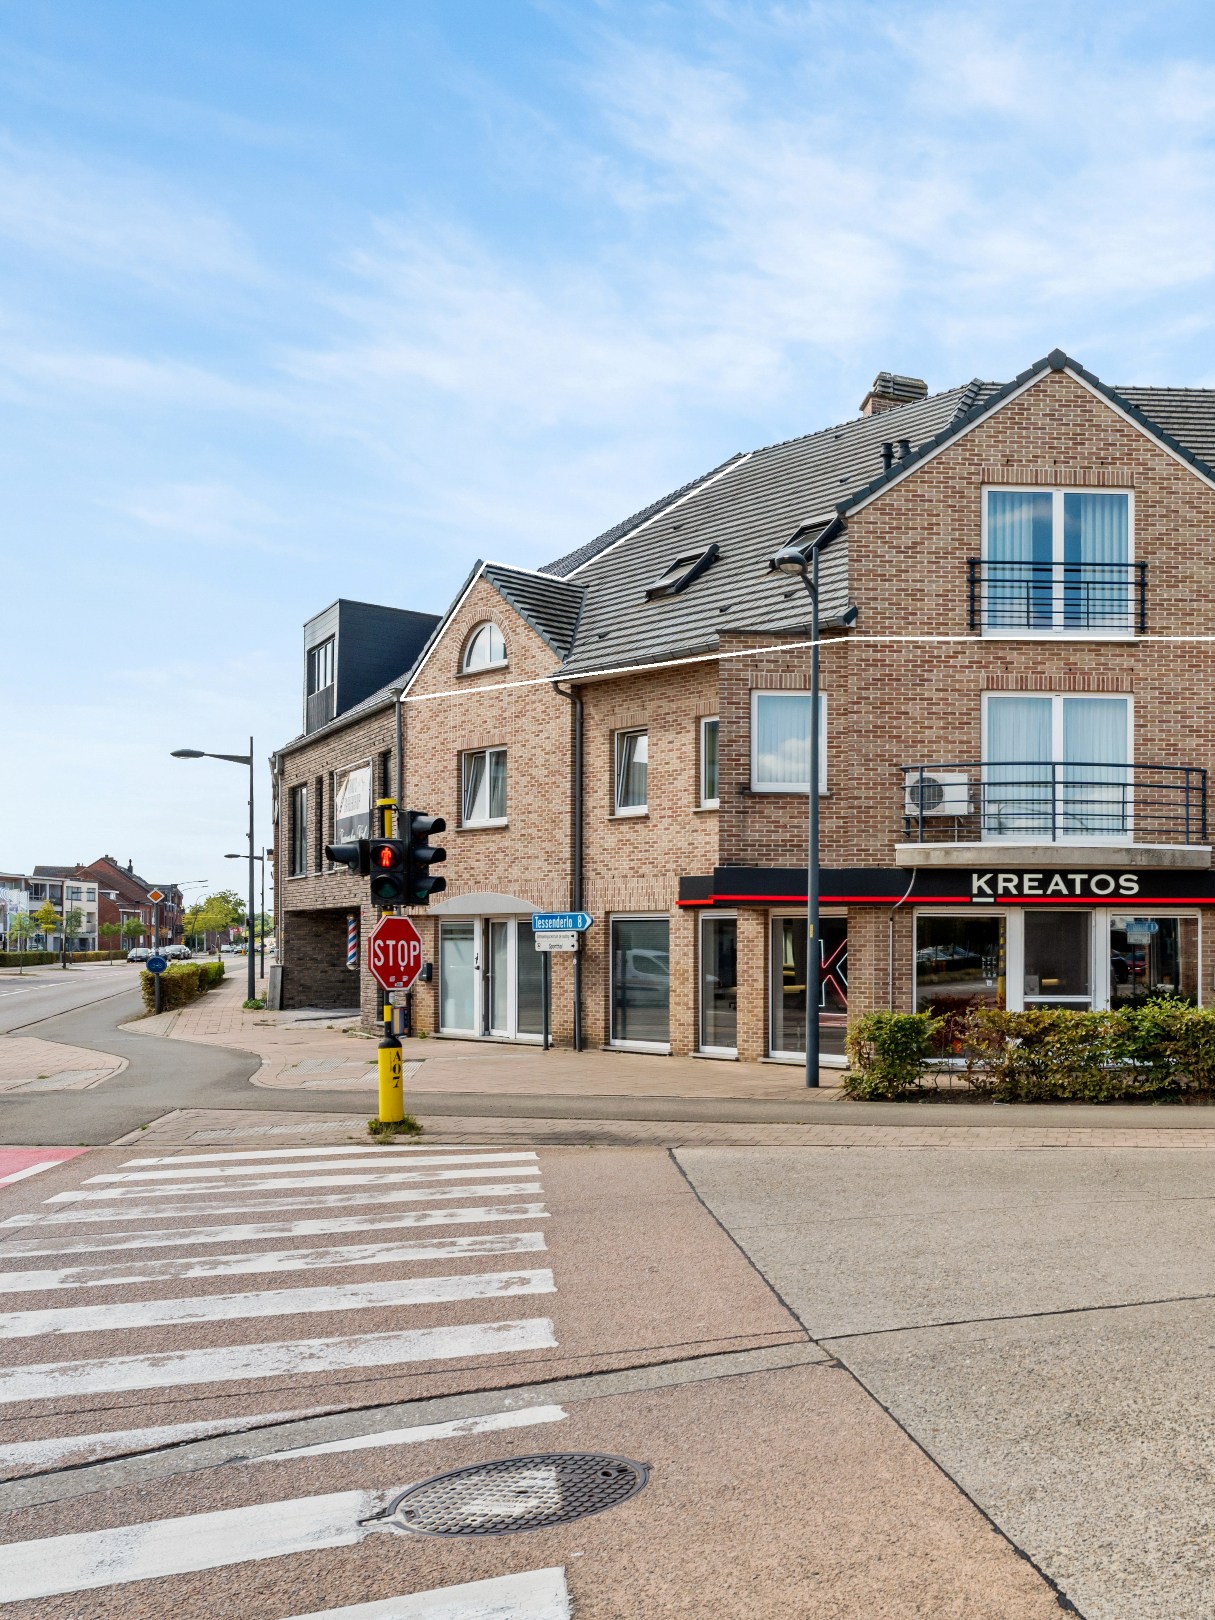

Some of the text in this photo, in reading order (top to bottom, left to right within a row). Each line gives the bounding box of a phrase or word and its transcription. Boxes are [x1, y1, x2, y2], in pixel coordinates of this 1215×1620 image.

[972, 873, 1140, 895] KREATOS
[535, 915, 582, 929] Tessenderlo 8
[374, 939, 420, 967] STOP
